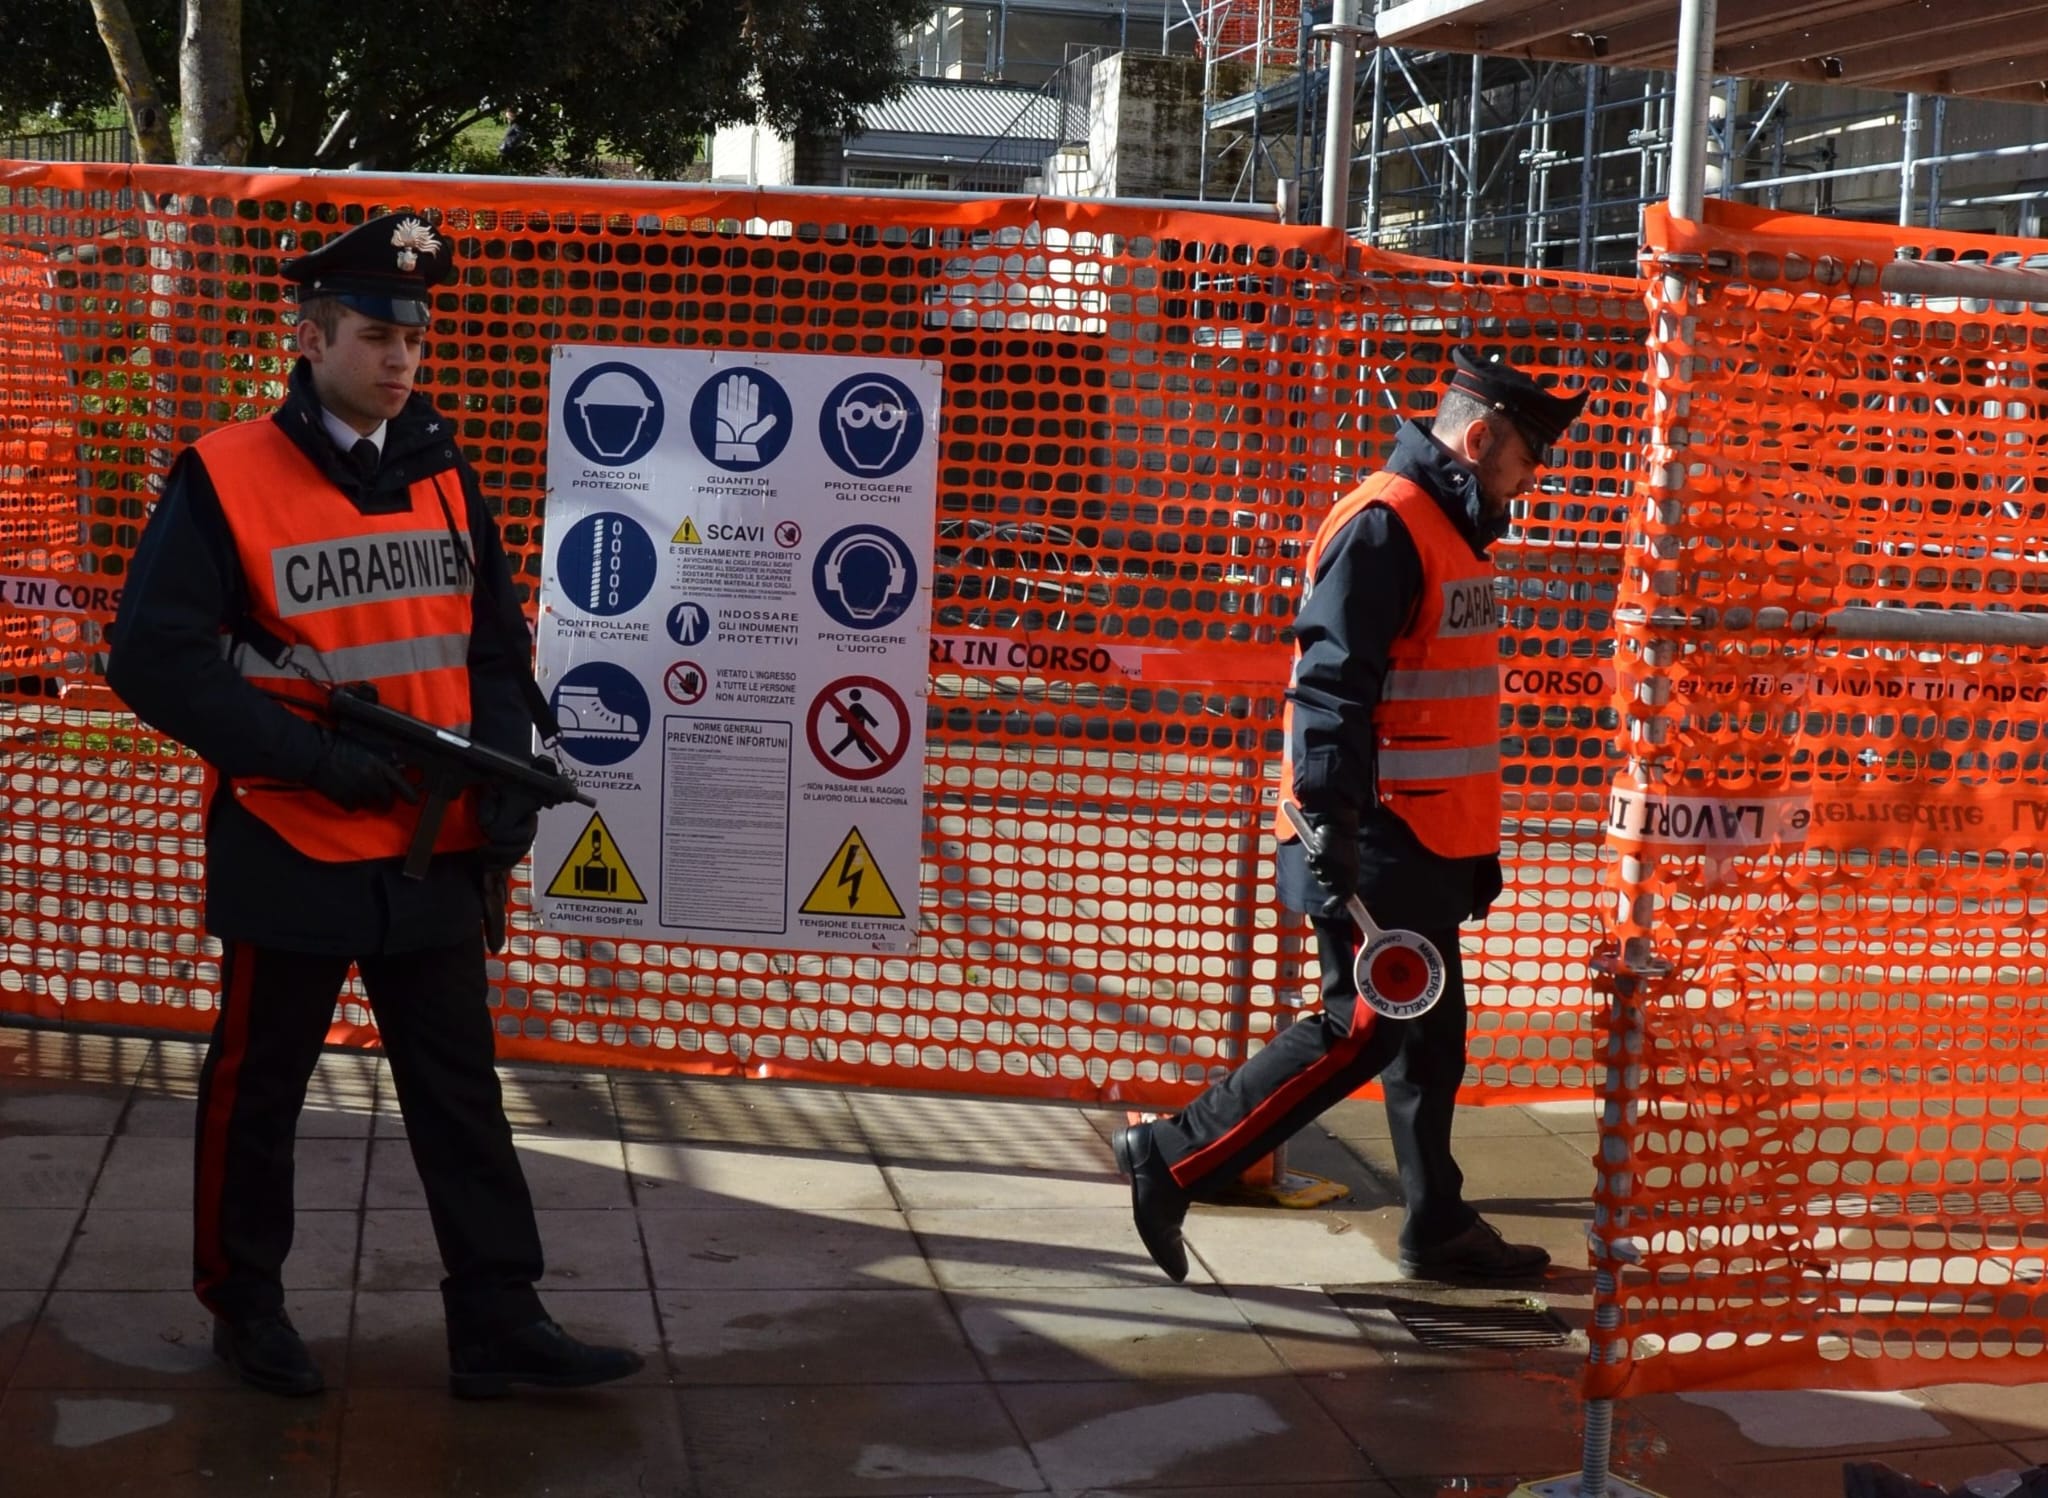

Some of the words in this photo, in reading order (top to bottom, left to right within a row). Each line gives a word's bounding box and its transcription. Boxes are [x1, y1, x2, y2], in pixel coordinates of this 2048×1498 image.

[582, 470, 625, 480] CASCO
[629, 472, 641, 480] DI
[572, 480, 649, 491] PROTEZIONE
[707, 476, 753, 486] GUANTI
[757, 478, 770, 487] DI
[824, 481, 913, 493] PROTEGGERE
[698, 486, 777, 497] PROTEZIONE
[835, 493, 857, 501] GLI
[860, 494, 901, 503] OCCHI
[707, 524, 764, 542] SCAVI
[678, 547, 753, 558] SEVERAMENTE
[754, 550, 802, 561] PROIBITO
[14, 581, 46, 605] IN
[55, 584, 122, 611] CORS
[718, 610, 799, 622] INDOSSARE
[557, 618, 650, 631] CONTROLLARE
[718, 622, 736, 631] GLI
[738, 623, 799, 634] INDUMENTI
[557, 629, 586, 639] FUNI
[589, 631, 597, 639] E
[600, 631, 649, 642] CATENE
[718, 634, 799, 646] PROTETTIVI
[818, 632, 907, 645] PROTEGGERE
[836, 644, 887, 654] L'UDITO
[962, 641, 998, 666] IN
[1007, 643, 1111, 674] CORSO
[716, 669, 748, 679] VIETATO
[750, 671, 797, 681] L'INGRESSO
[716, 681, 721, 689] A
[723, 681, 747, 691] TUTTE
[749, 683, 758, 691] LE
[760, 683, 797, 693] PERSONE
[1504, 669, 1603, 696] CORSO
[716, 693, 735, 702] NON
[736, 694, 796, 705] AUTORIZZATE
[693, 723, 721, 732] NORME
[724, 724, 763, 734] GENERALI
[667, 732, 734, 745] PREVENZIONE
[736, 735, 788, 748] INFORTUNI
[573, 779, 642, 791] SICUREZZA
[824, 783, 858, 792] PASSARE
[860, 785, 874, 793] NEL
[876, 786, 906, 795] RAGGIO
[803, 793, 811, 801] DI
[812, 794, 842, 803] LAVORO
[844, 795, 868, 804] DELLA
[869, 796, 908, 806] MACCHINA
[556, 903, 624, 914] ATTENZIONE
[626, 907, 637, 916] AI
[549, 912, 593, 923] CARICHI
[595, 916, 643, 927] SOSPESI
[799, 919, 848, 929] TENSIONE
[851, 921, 906, 931] ELETTRICA
[818, 930, 886, 941] PERICOLOSA
[1361, 978, 1390, 1011] DIFESA
[1393, 998, 1428, 1014] DELLA
